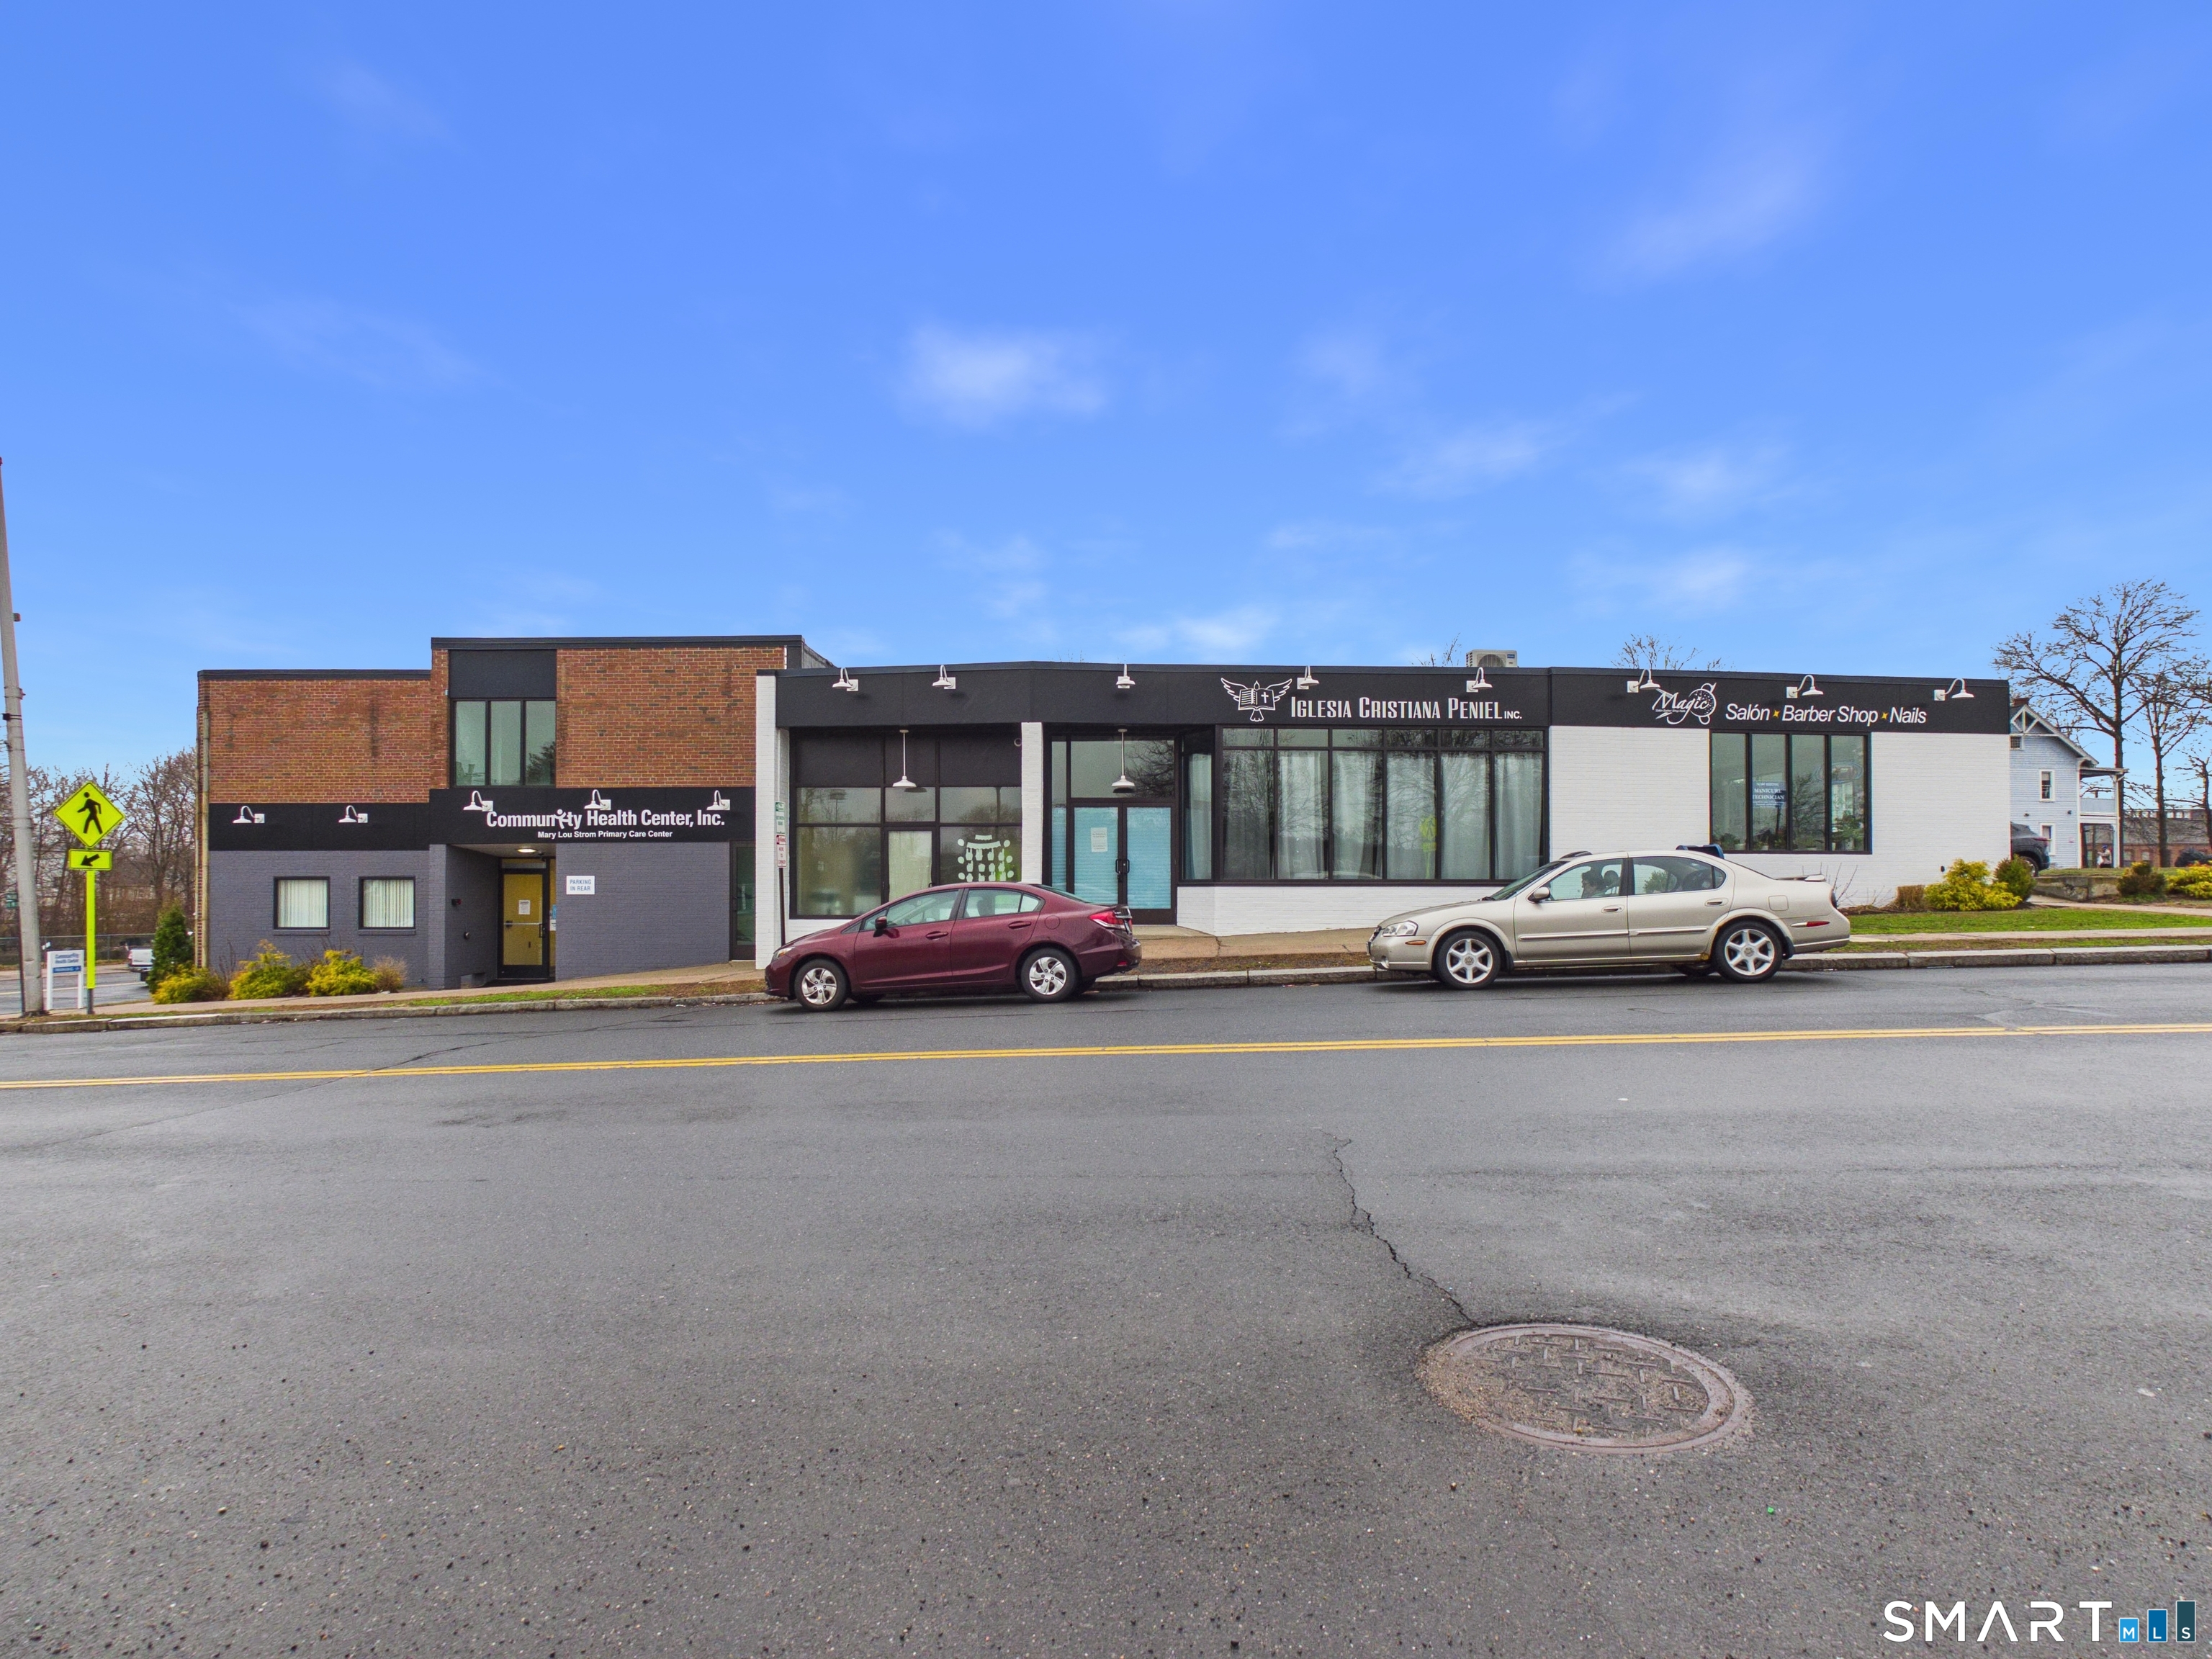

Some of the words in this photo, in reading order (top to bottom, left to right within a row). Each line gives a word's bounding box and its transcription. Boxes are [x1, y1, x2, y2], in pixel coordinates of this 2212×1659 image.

[1291, 696, 1352, 718] IGLESIA
[1359, 697, 1440, 719] CRISTIANA
[1448, 698, 1503, 719] PENIEL
[1504, 711, 1522, 719] INC.
[1652, 688, 1709, 724] Magic
[1725, 703, 1771, 721] Salón
[1782, 705, 1835, 722] Barber
[1837, 706, 1879, 727] Shop
[1889, 706, 1927, 724] Nails
[487, 809, 583, 830] Community
[587, 810, 637, 826] Health
[641, 809, 694, 827] Center,
[697, 809, 725, 826] Inc.
[538, 831, 556, 840] Mary
[598, 830, 627, 839] Primary
